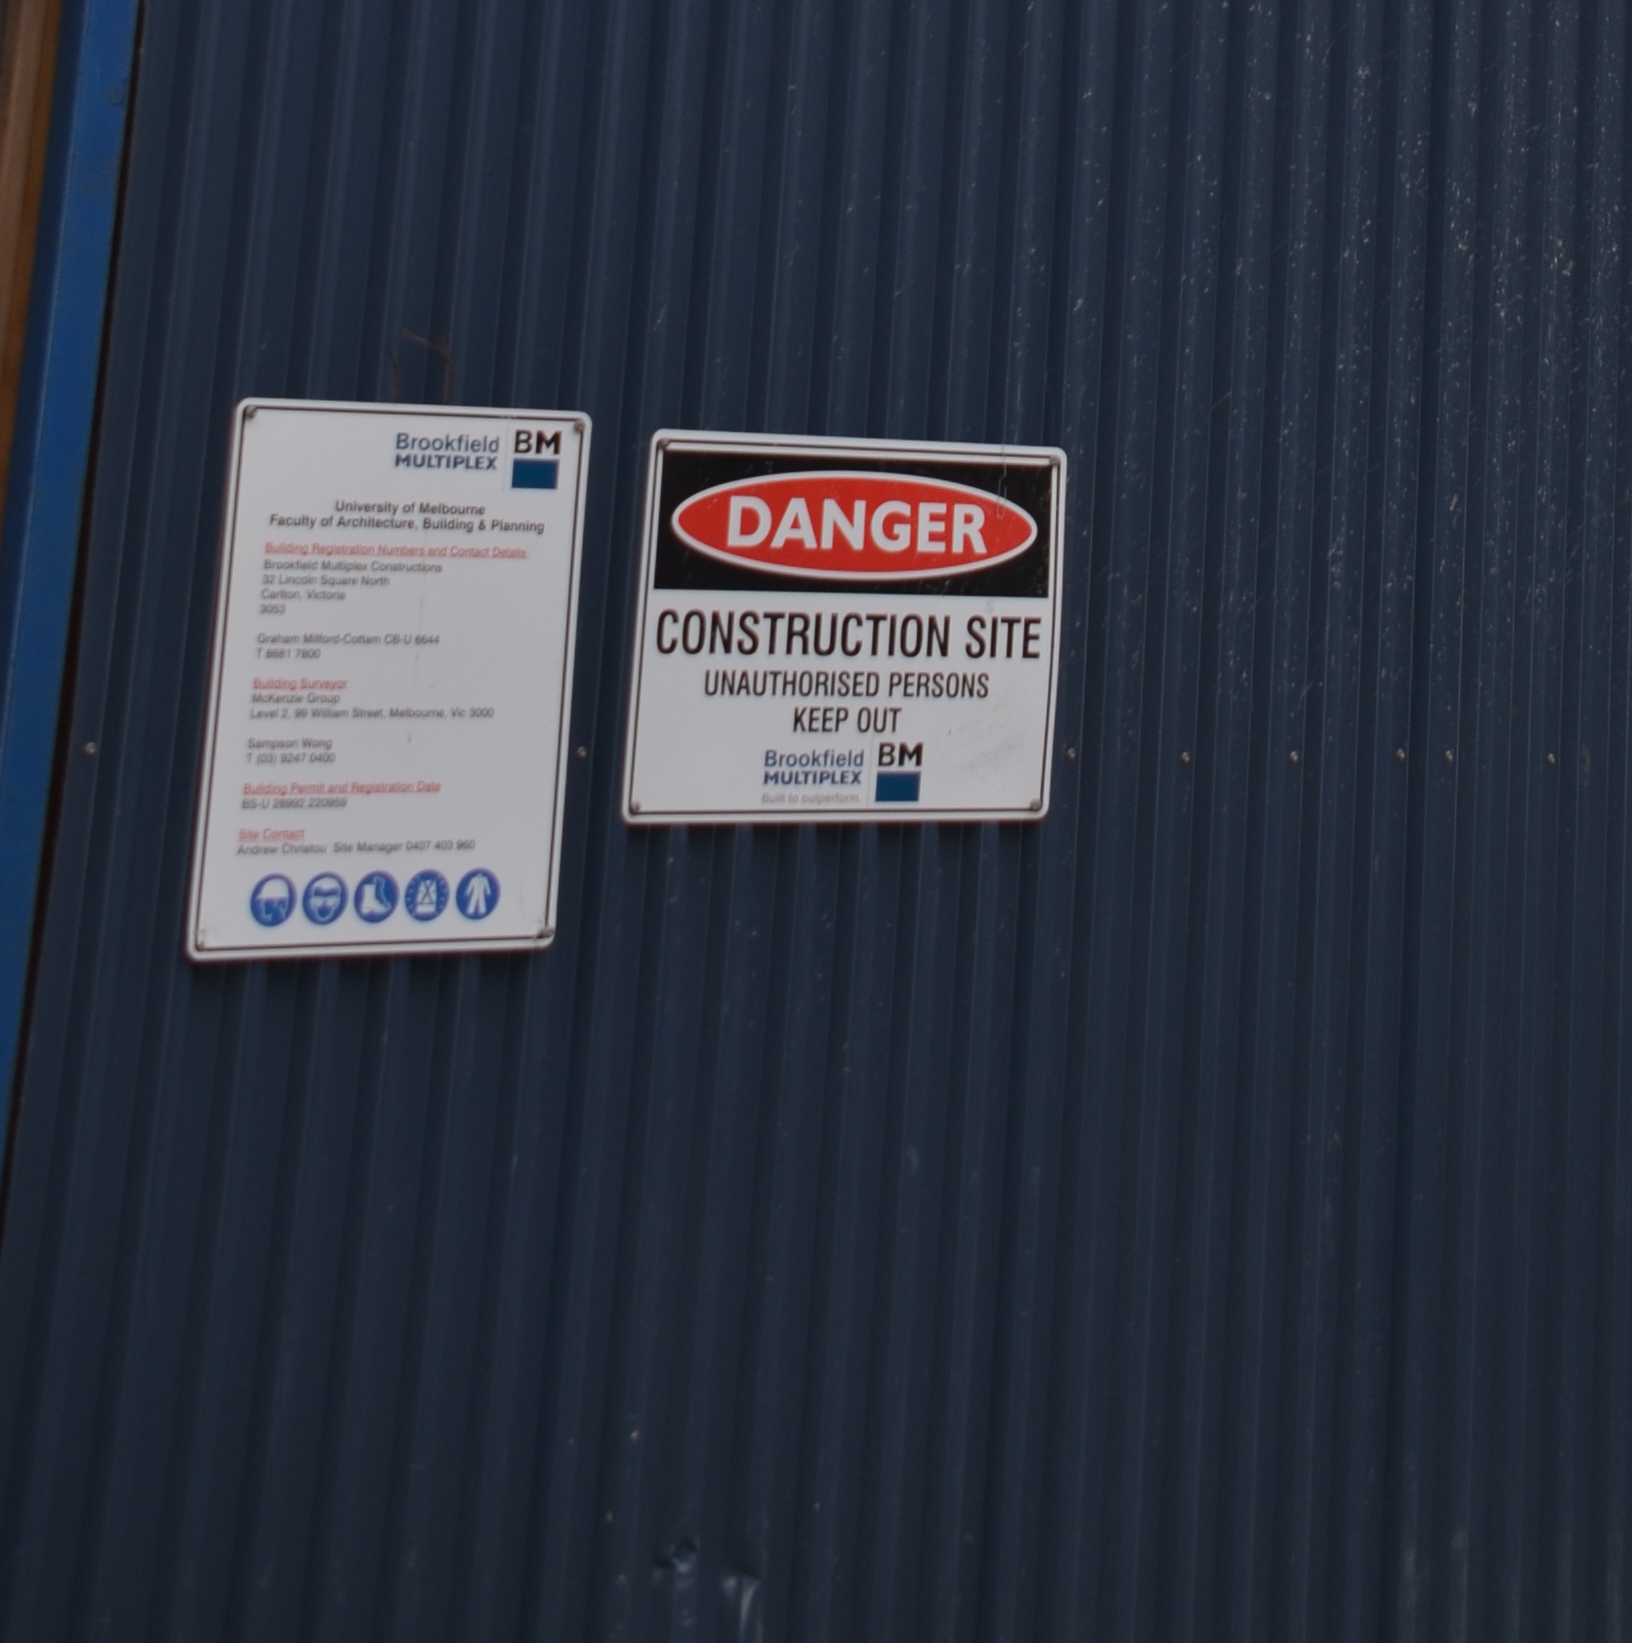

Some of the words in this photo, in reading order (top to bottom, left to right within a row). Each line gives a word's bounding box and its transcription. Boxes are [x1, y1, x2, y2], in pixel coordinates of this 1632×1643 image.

[395, 432, 500, 454] Brookfield
[513, 429, 562, 456] BM
[394, 453, 497, 472] MULTIPLEX
[335, 500, 399, 515] University
[403, 501, 416, 513] of
[419, 502, 486, 515] Melbourne
[270, 513, 316, 529] Faculty
[321, 515, 334, 527] of
[337, 515, 419, 530] Architecture,
[423, 518, 474, 533] Building
[478, 519, 487, 531] &
[491, 520, 545, 535] Planning
[726, 495, 988, 554] DANGER
[265, 541, 309, 555] Building
[312, 543, 375, 556] Registration
[378, 544, 425, 556] Numbers
[428, 546, 448, 557] and
[450, 546, 490, 558] Contact
[263, 559, 318, 571] Brookfield
[321, 561, 368, 573] Multiplex
[371, 562, 443, 573] Constructions
[263, 574, 275, 585] 32
[278, 575, 317, 586] Lincoln
[320, 576, 358, 588] Square
[361, 577, 390, 587] North
[306, 590, 346, 601] Victoria
[257, 632, 300, 645] Graham
[656, 608, 951, 658] CONSTRUCTION
[965, 614, 1042, 659] SITE
[252, 677, 298, 691] Building
[300, 678, 349, 691] Surveyor
[704, 669, 880, 699] UNAUTHORISED
[888, 671, 990, 699] PERSONS
[252, 693, 304, 704] McKenzie
[307, 693, 341, 705] Group
[250, 708, 279, 719] Level
[311, 708, 349, 719] William
[450, 707, 467, 718] Vic
[469, 707, 495, 718] 3000
[792, 706, 849, 734] KEEP
[857, 707, 903, 734] OUT
[247, 737, 299, 750] Sampson
[301, 737, 333, 751] Wong
[763, 747, 865, 767] Brookfield
[877, 742, 923, 767] BM
[763, 770, 862, 786] MULTIPLEX
[243, 782, 287, 797] Building
[290, 782, 325, 795] Permit
[328, 782, 348, 794] and
[350, 781, 415, 796] Registration
[762, 792, 786, 804] Built
[788, 793, 800, 804] to
[238, 829, 260, 842] Site
[262, 828, 305, 842] Contact
[237, 842, 279, 855] Andrew
[333, 842, 354, 854] Site
[356, 841, 403, 854] Manager
